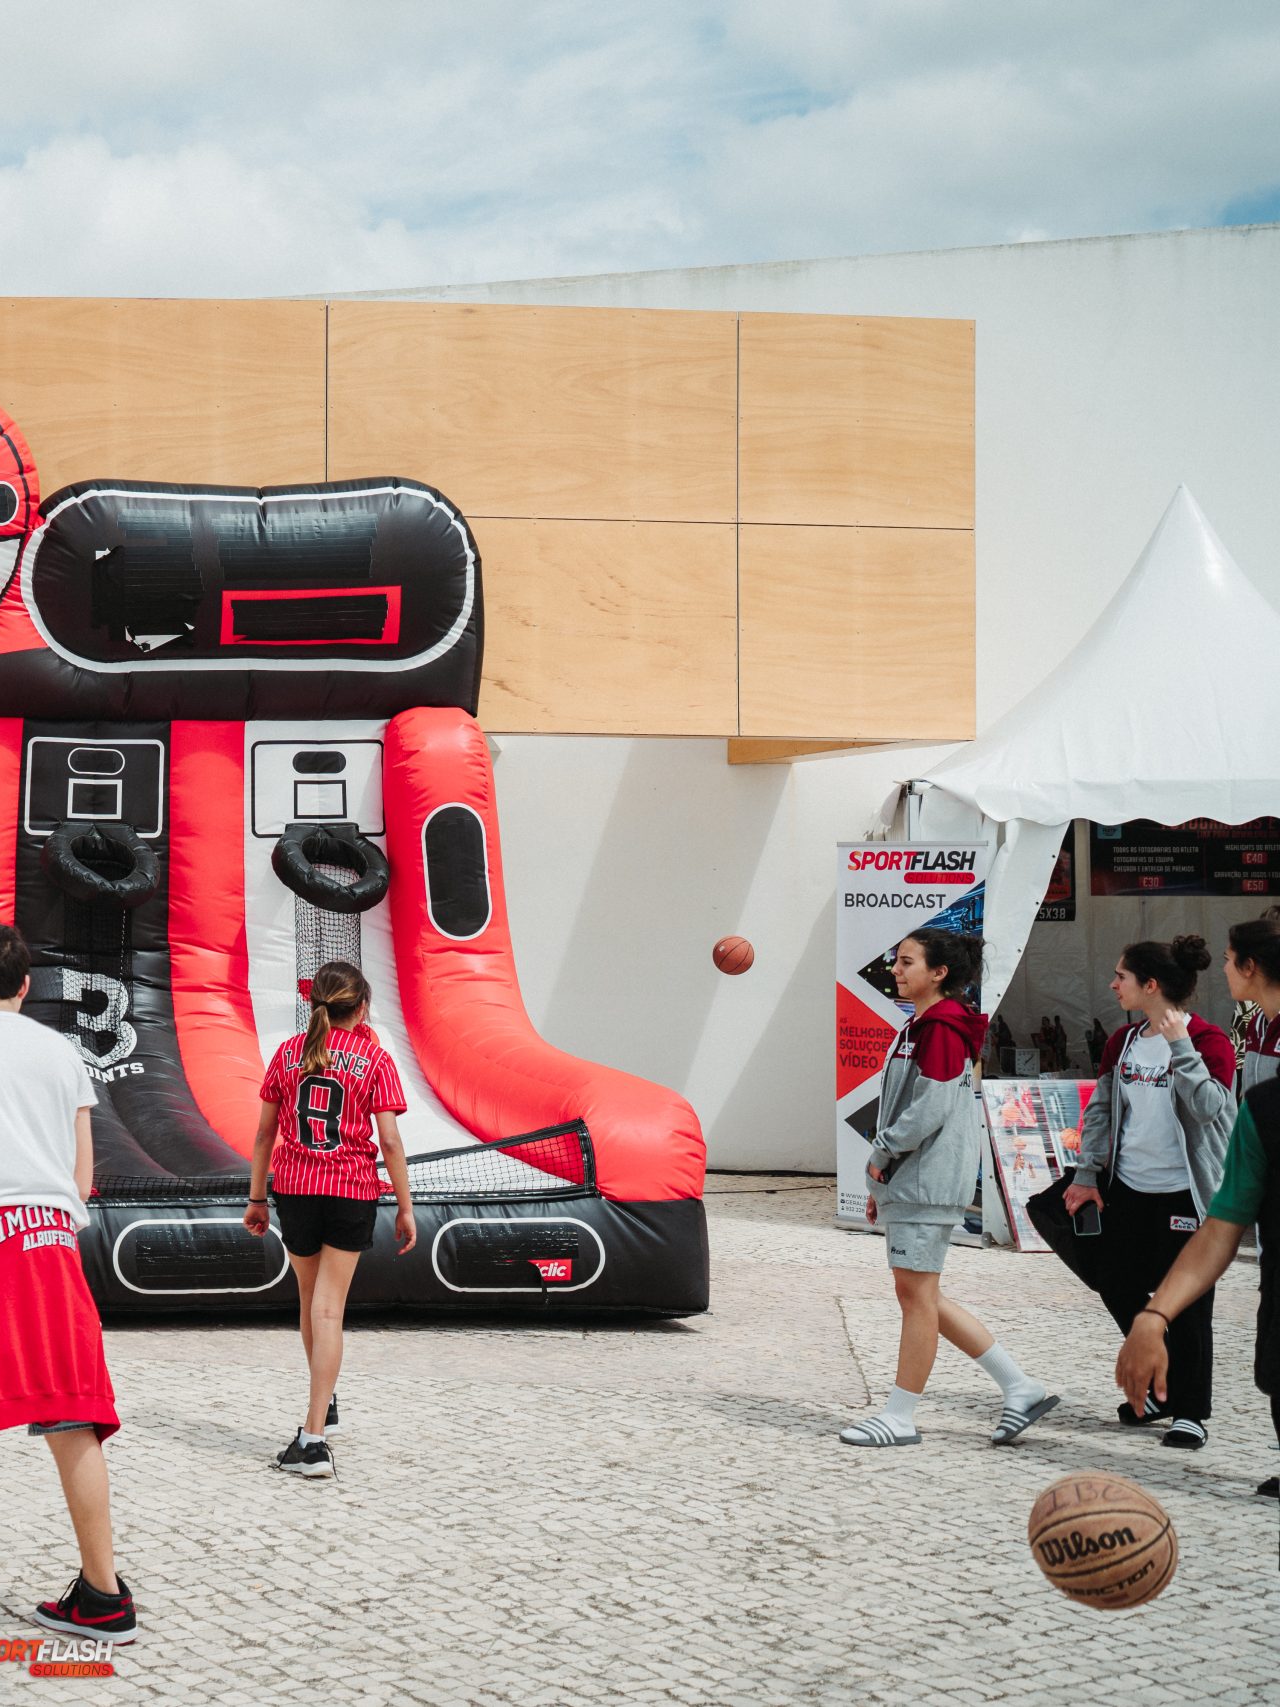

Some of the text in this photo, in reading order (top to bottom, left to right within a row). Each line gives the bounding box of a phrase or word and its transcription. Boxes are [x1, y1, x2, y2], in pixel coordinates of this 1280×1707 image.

[848, 850, 976, 871] SPORTFLASH
[906, 873, 972, 883] SOLUTIONS
[844, 893, 946, 908] BROADCAST
[62, 967, 138, 1068] 3
[840, 1026, 896, 1039] MELHORES
[285, 1050, 370, 1079] LINE
[839, 1051, 878, 1068] VÍDEO
[84, 1062, 145, 1083] OINTS
[295, 1075, 345, 1152] 8
[1038, 1527, 1137, 1567] Wilson
